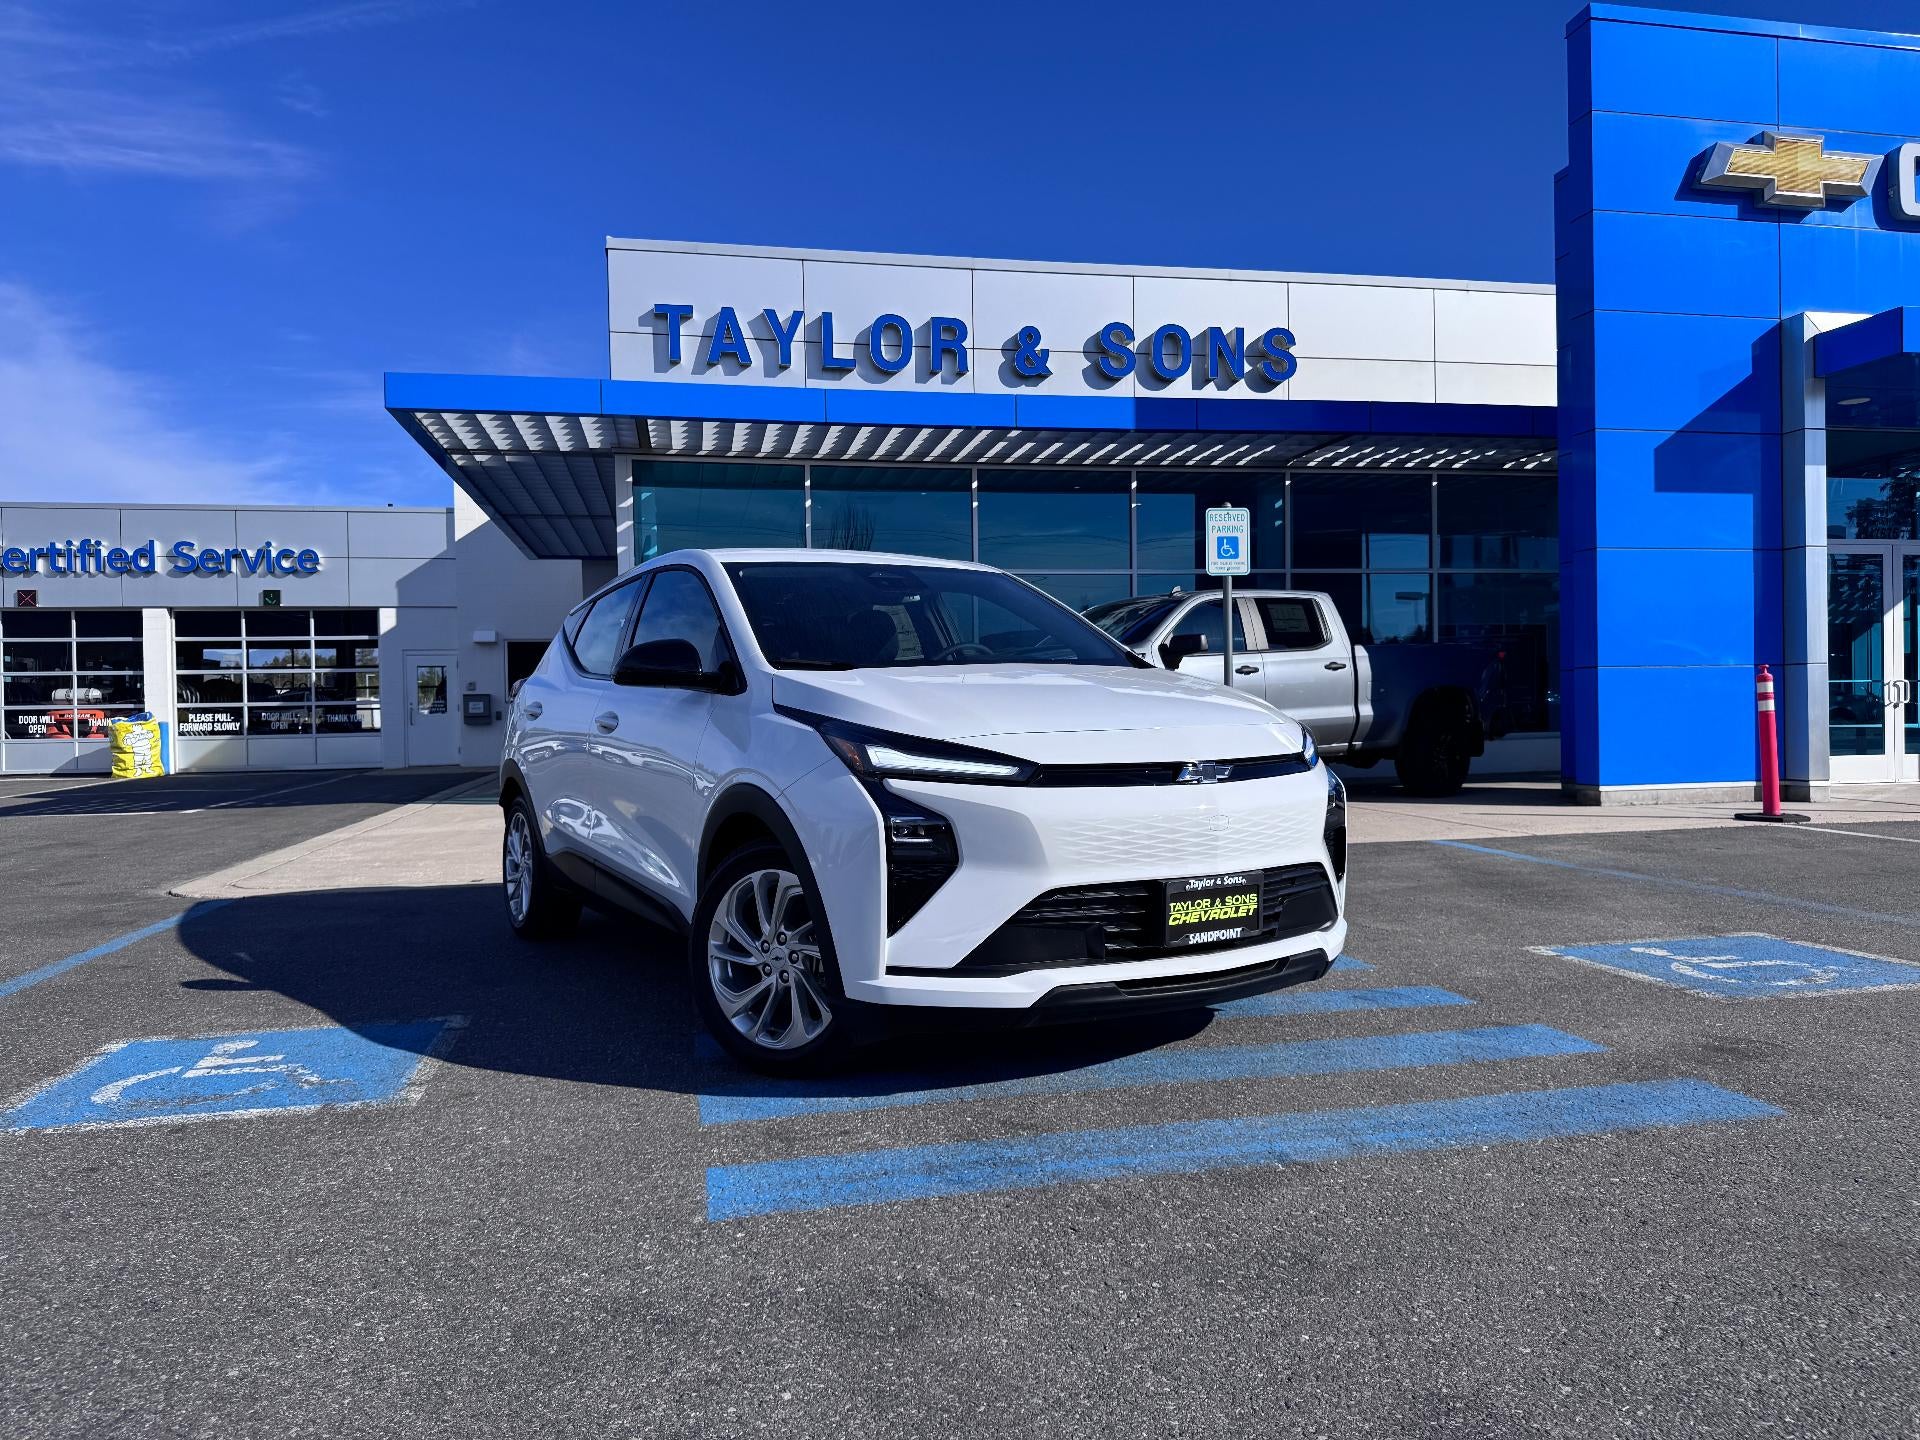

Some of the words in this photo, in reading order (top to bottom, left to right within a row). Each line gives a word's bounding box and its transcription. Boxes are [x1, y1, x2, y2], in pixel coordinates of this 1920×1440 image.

[654, 302, 970, 376] TAYLOR
[1013, 325, 1051, 377] &
[1098, 321, 1298, 383] SONS
[1209, 513, 1246, 522] RESERVED
[1211, 525, 1244, 534] PARKING
[172, 540, 321, 573] Service
[18, 715, 39, 725] DOOR
[39, 714, 57, 724] WILL
[188, 713, 214, 723] PLEASE
[261, 712, 280, 721] DOOR
[281, 712, 296, 721] WILL
[327, 713, 349, 723] THANK
[28, 724, 47, 734] OPEN
[179, 722, 212, 732] FORWARD
[213, 721, 241, 731] SLOWLY
[270, 721, 289, 730] OPEN
[1189, 877, 1215, 890] Taylor
[1216, 877, 1222, 885] &
[1223, 875, 1243, 886] Sons
[1169, 898, 1211, 913] TAYLOR
[1213, 897, 1222, 908] &
[1225, 893, 1257, 906] SONS
[1168, 904, 1258, 926] CHEVROLET
[1188, 927, 1243, 945] SANDPOINT
